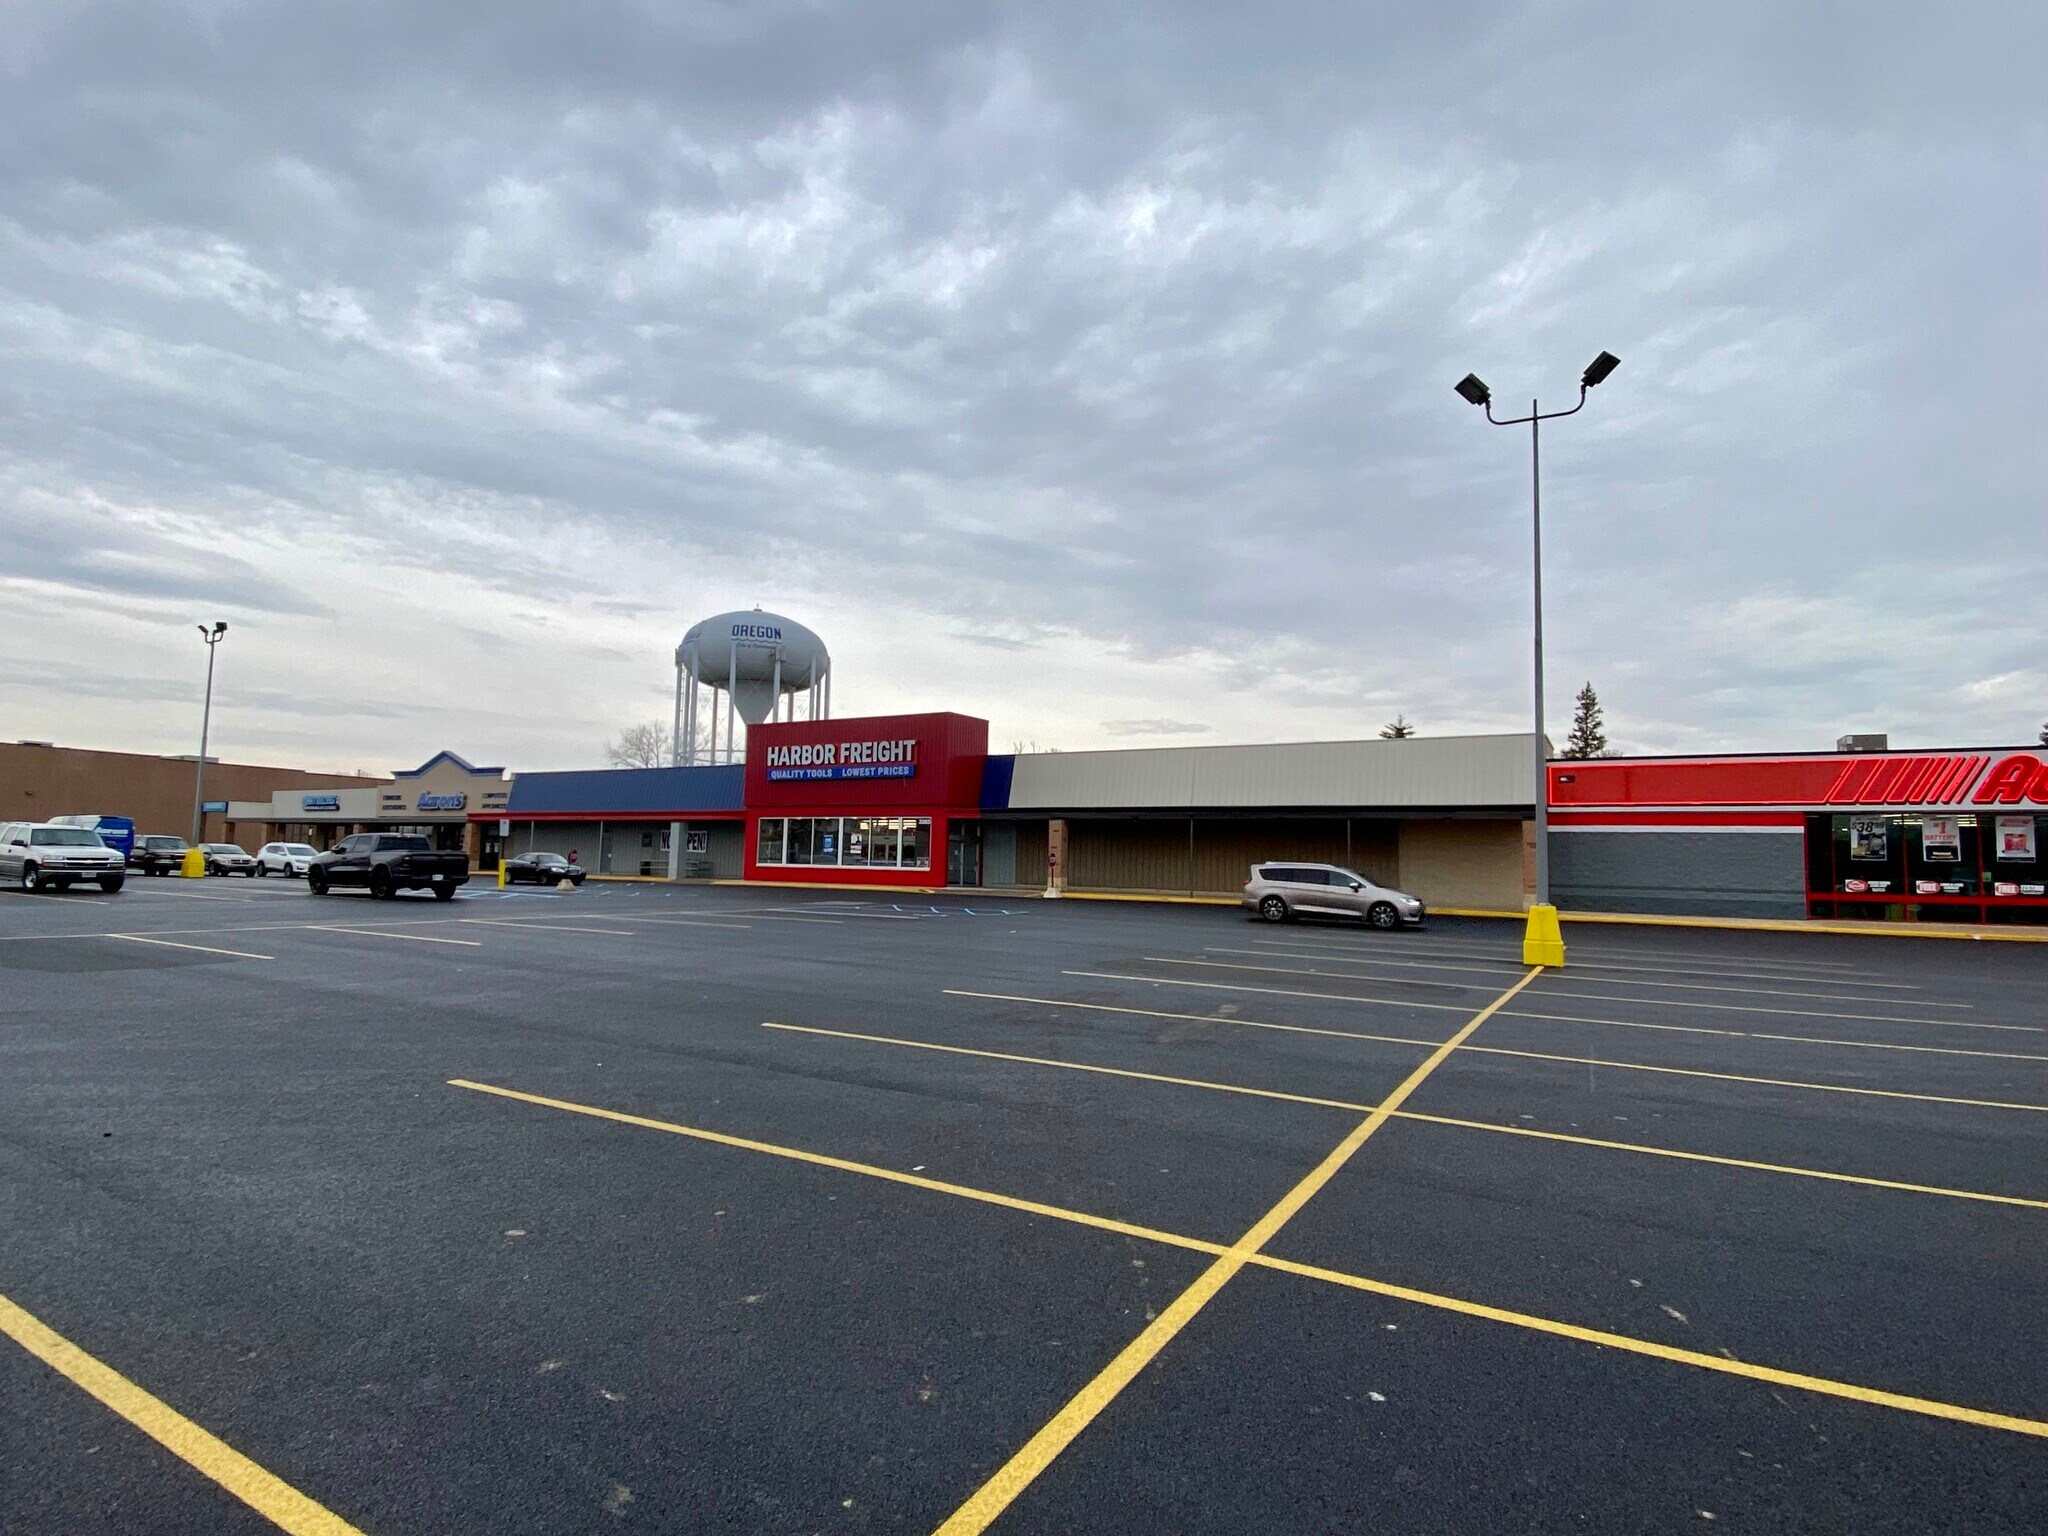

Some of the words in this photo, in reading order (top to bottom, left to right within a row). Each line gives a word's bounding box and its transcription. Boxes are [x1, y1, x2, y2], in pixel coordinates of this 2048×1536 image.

[732, 624, 782, 640] OREGON
[767, 744, 835, 766] HARBOR
[840, 740, 916, 764] FREIGHT
[771, 769, 804, 779] QUALITY
[806, 769, 833, 778] TOOLS
[842, 767, 876, 777] LOWEST
[877, 766, 910, 776] PRICES
[417, 791, 466, 809] Aaron's
[687, 832, 706, 851] PEN!
